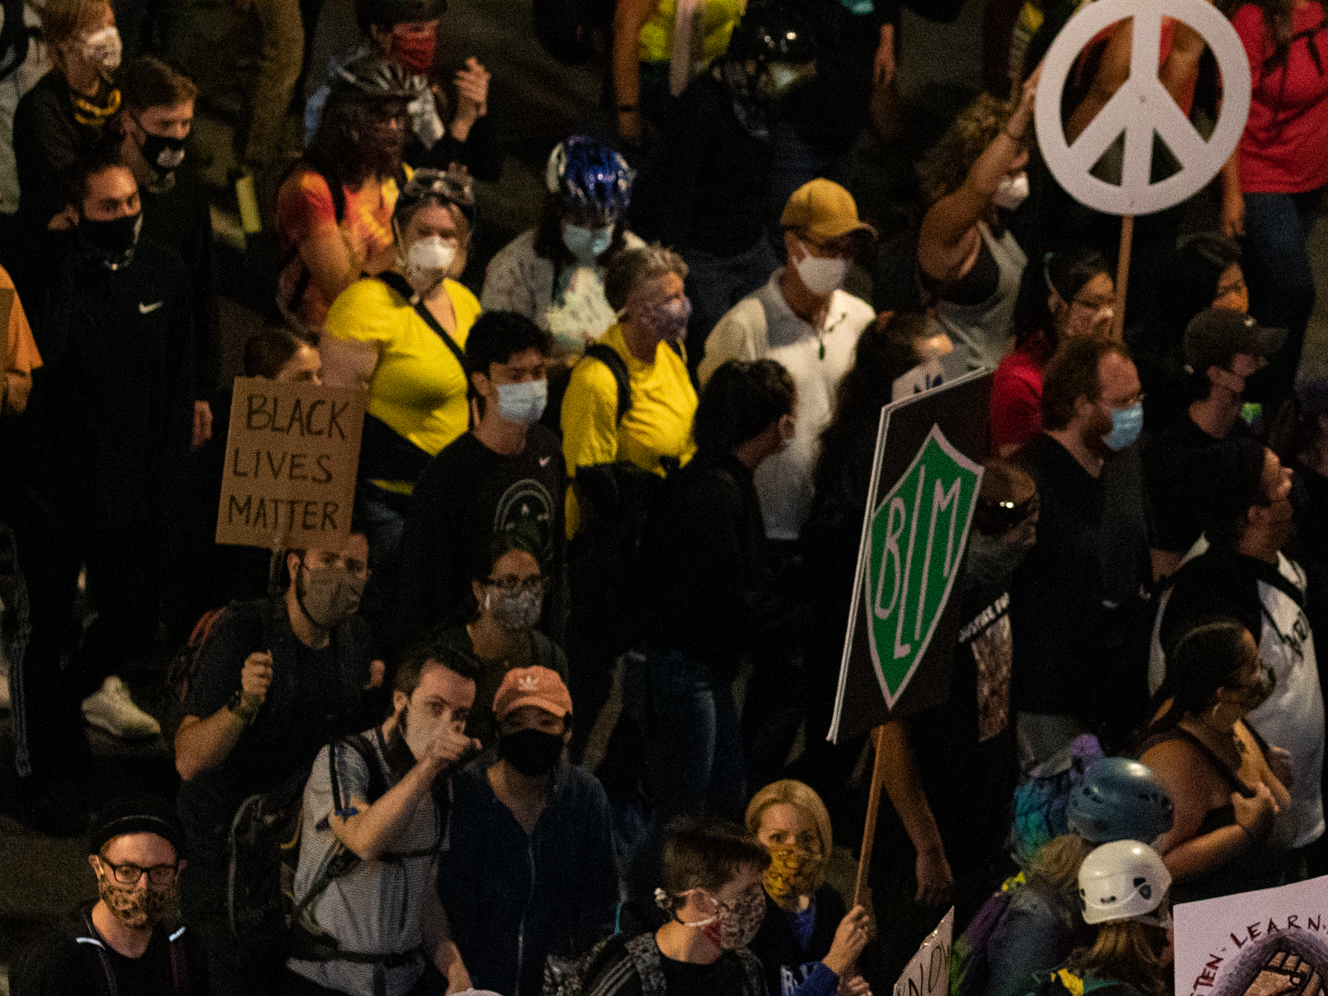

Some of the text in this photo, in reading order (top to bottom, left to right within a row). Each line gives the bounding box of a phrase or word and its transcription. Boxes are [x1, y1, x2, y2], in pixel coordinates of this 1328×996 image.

[246, 394, 349, 440] BLACK
[233, 448, 333, 484] LIVES
[228, 494, 338, 533] MATTER
[874, 464, 962, 660] BLM
[1229, 914, 1321, 949] LEARN
